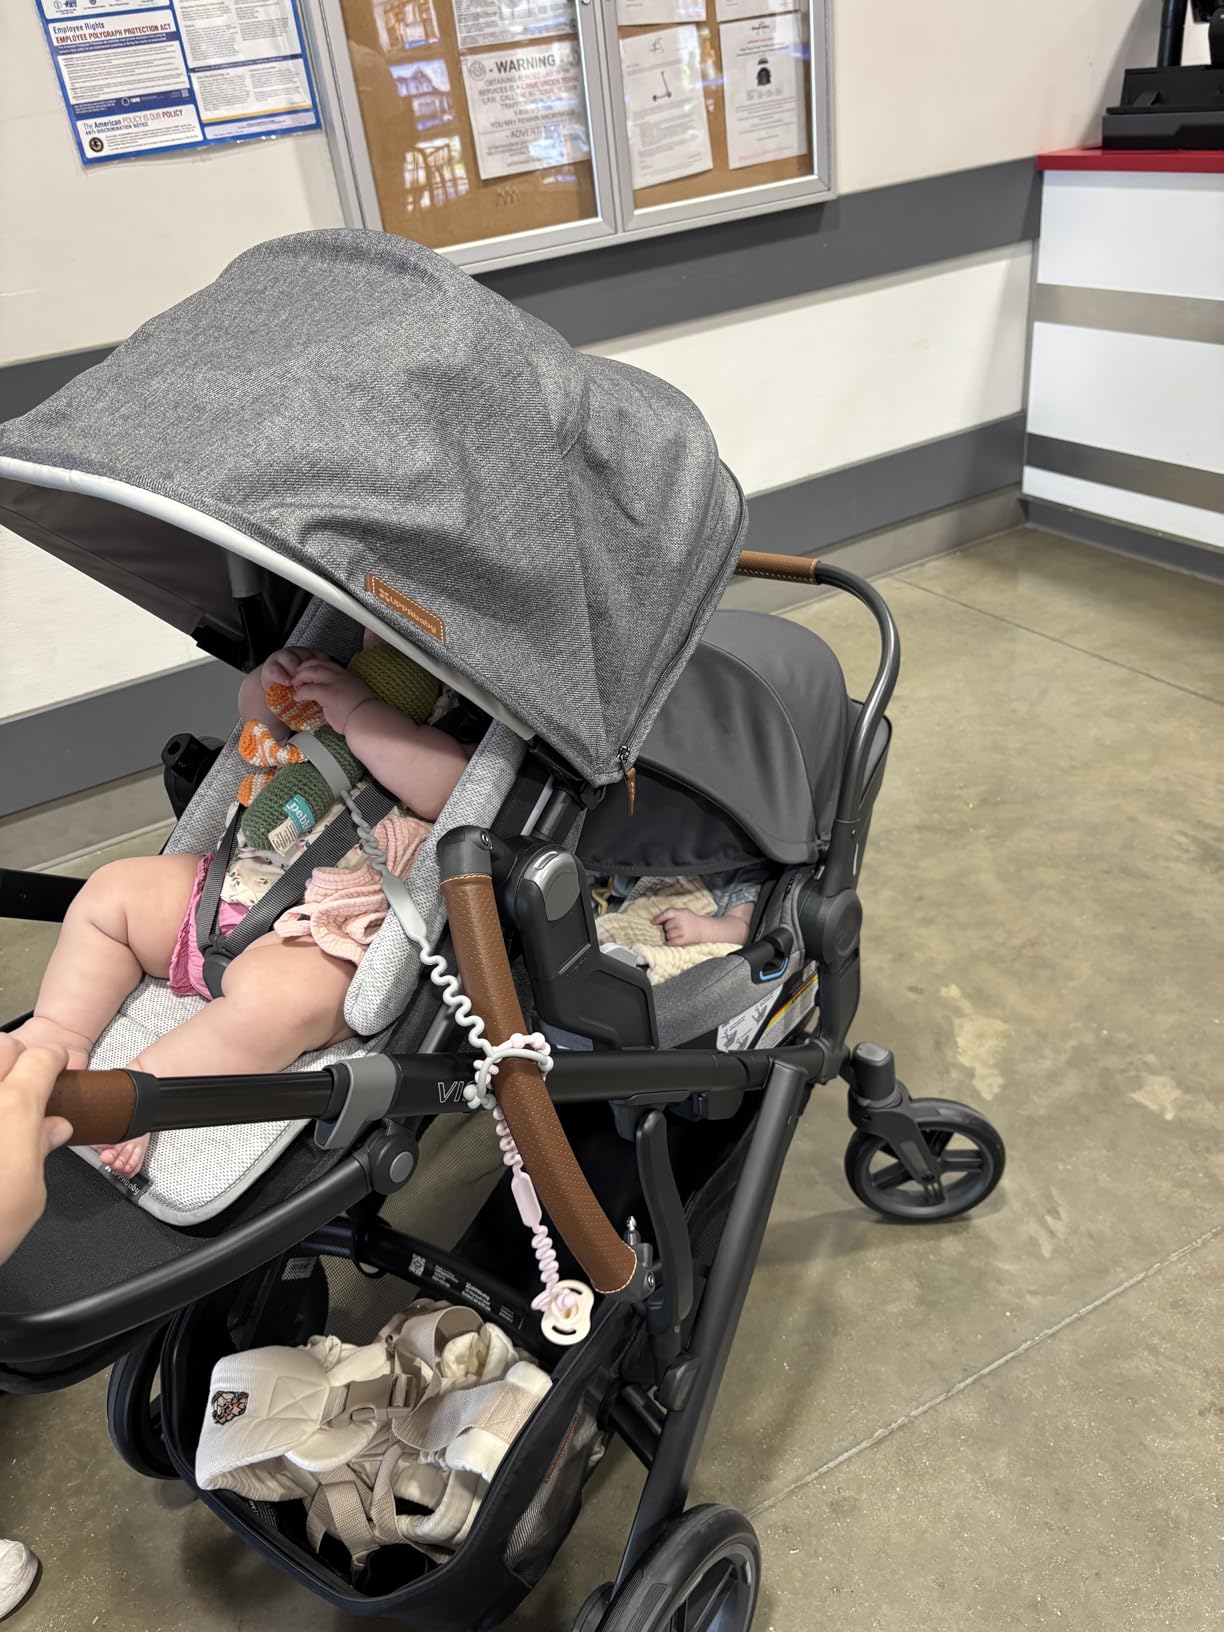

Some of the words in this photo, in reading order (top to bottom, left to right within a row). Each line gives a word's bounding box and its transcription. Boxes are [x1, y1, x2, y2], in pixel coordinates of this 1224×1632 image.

[53, 24, 84, 35] Employee
[85, 22, 105, 32] Rights
[55, 33, 87, 44] EMPLOYEE
[89, 30, 123, 40] POLYGRAPH
[124, 26, 159, 36] PROTECTION
[160, 23, 171, 31] ACT
[495, 54, 556, 75] WARNING
[94, 118, 121, 129] American
[162, 109, 184, 119] POLICY
